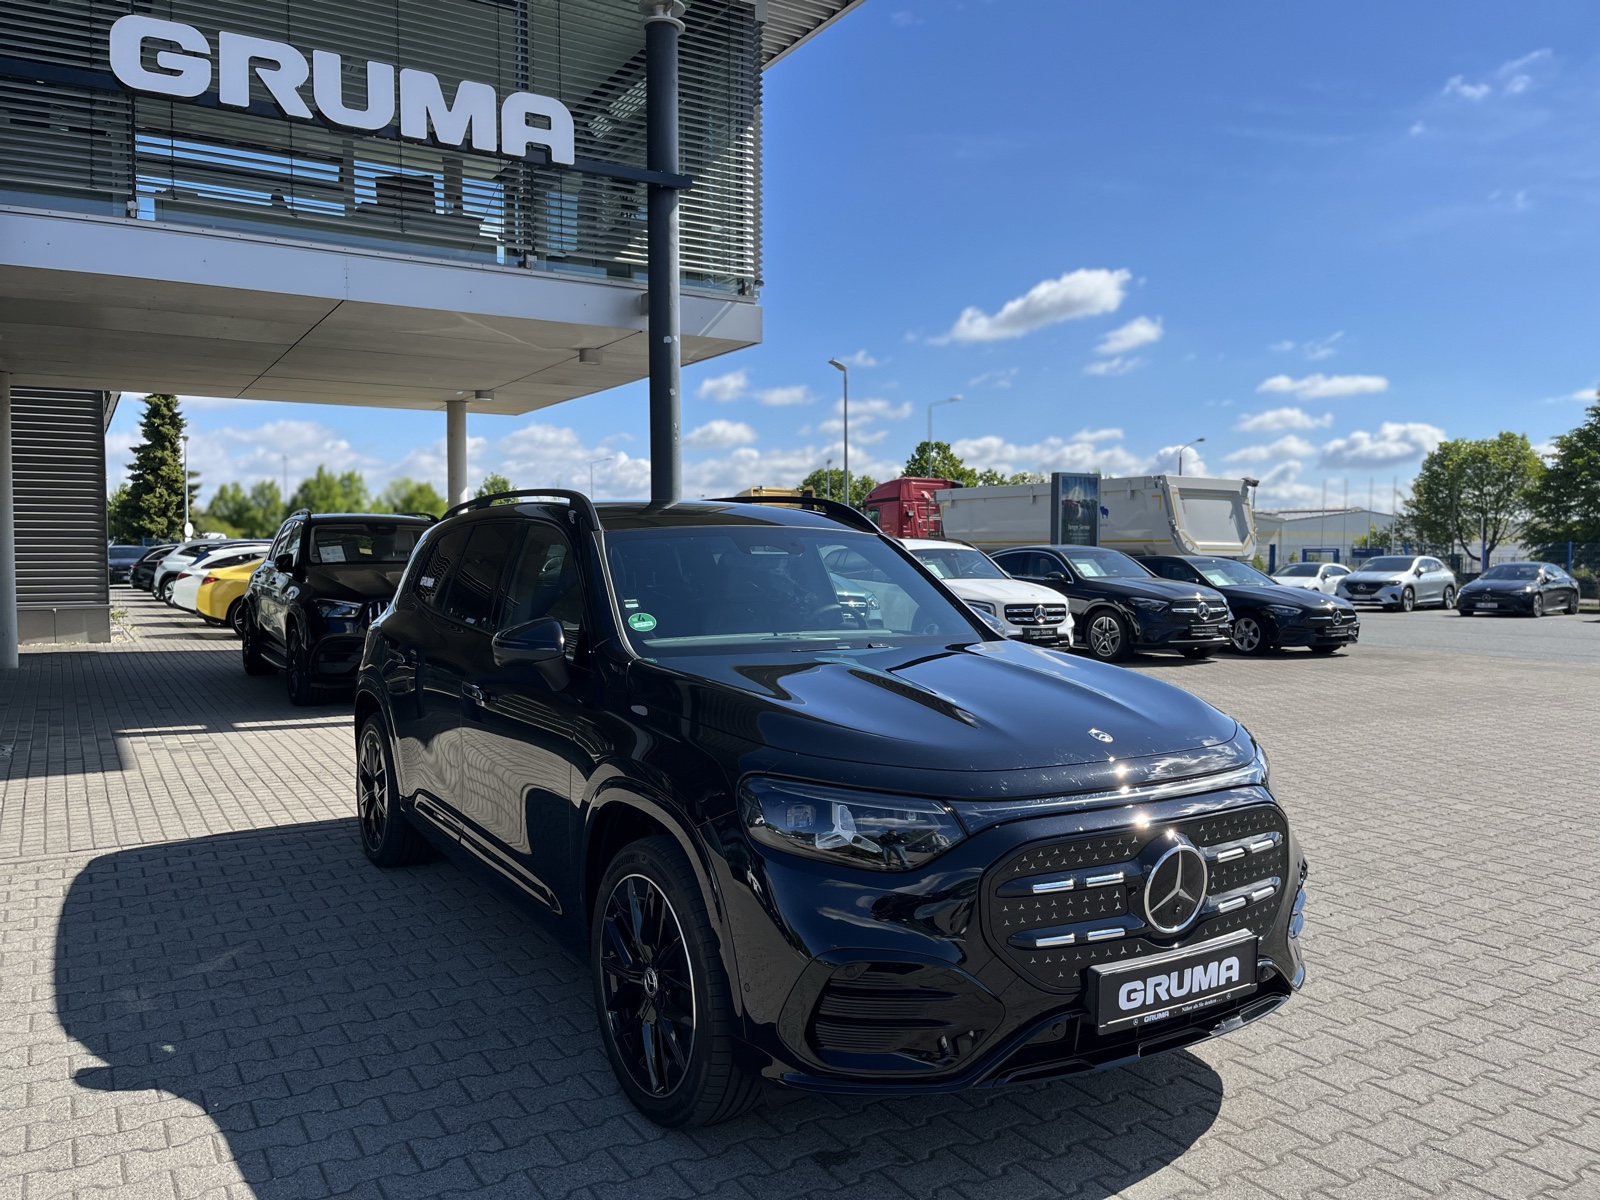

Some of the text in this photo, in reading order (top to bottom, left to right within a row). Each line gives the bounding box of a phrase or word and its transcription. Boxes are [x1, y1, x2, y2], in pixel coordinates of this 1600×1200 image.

[109, 14, 575, 166] GRUMA
[1118, 956, 1239, 1010] GRUMA
[1143, 1011, 1169, 1022] GRUMA
